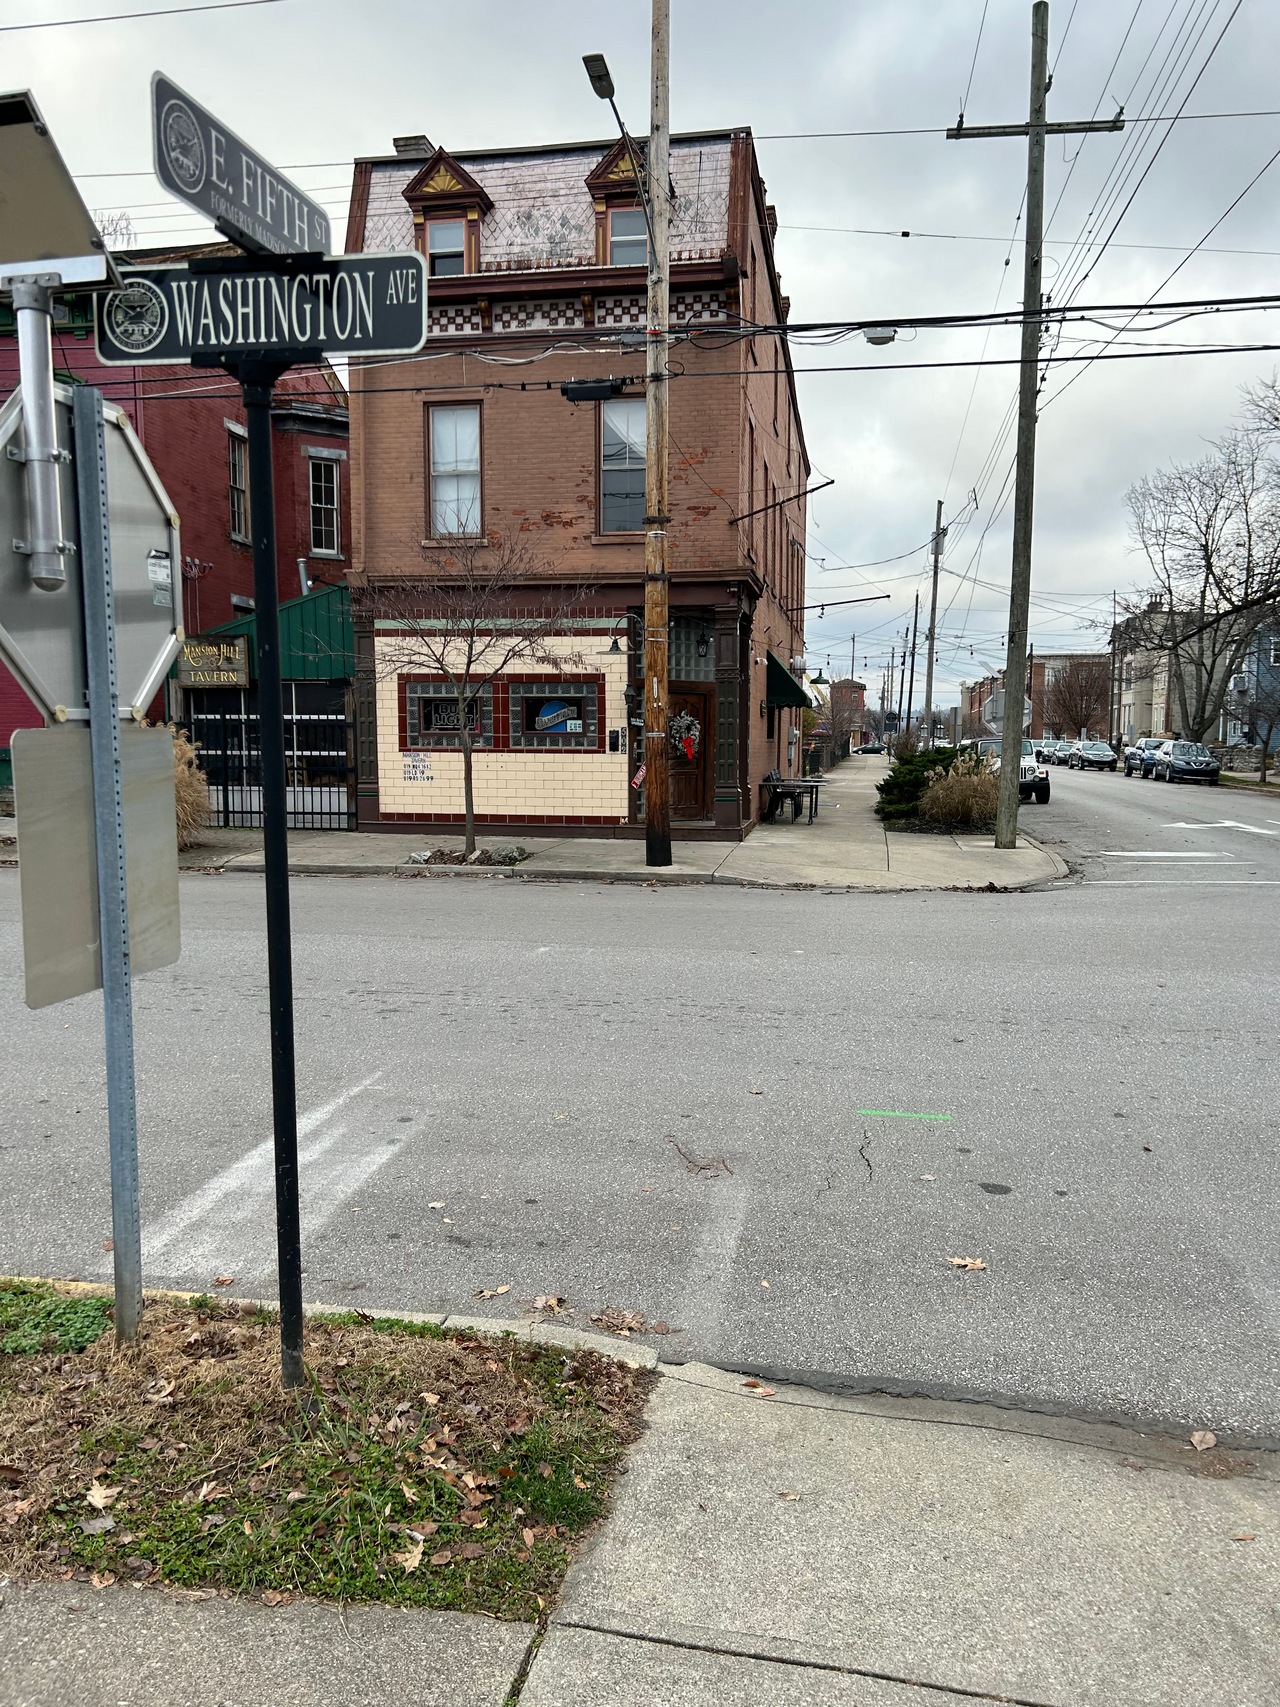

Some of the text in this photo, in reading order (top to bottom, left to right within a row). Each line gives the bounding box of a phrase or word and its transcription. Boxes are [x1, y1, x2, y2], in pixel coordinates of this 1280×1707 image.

[208, 126, 233, 195] E.
[240, 152, 310, 253] FIFTH
[314, 215, 327, 244] ST
[210, 190, 254, 236] FORMERLY
[170, 269, 417, 347] WASHINGTON AVE
[189, 671, 237, 682] TAVERN
[439, 704, 467, 715] BU
